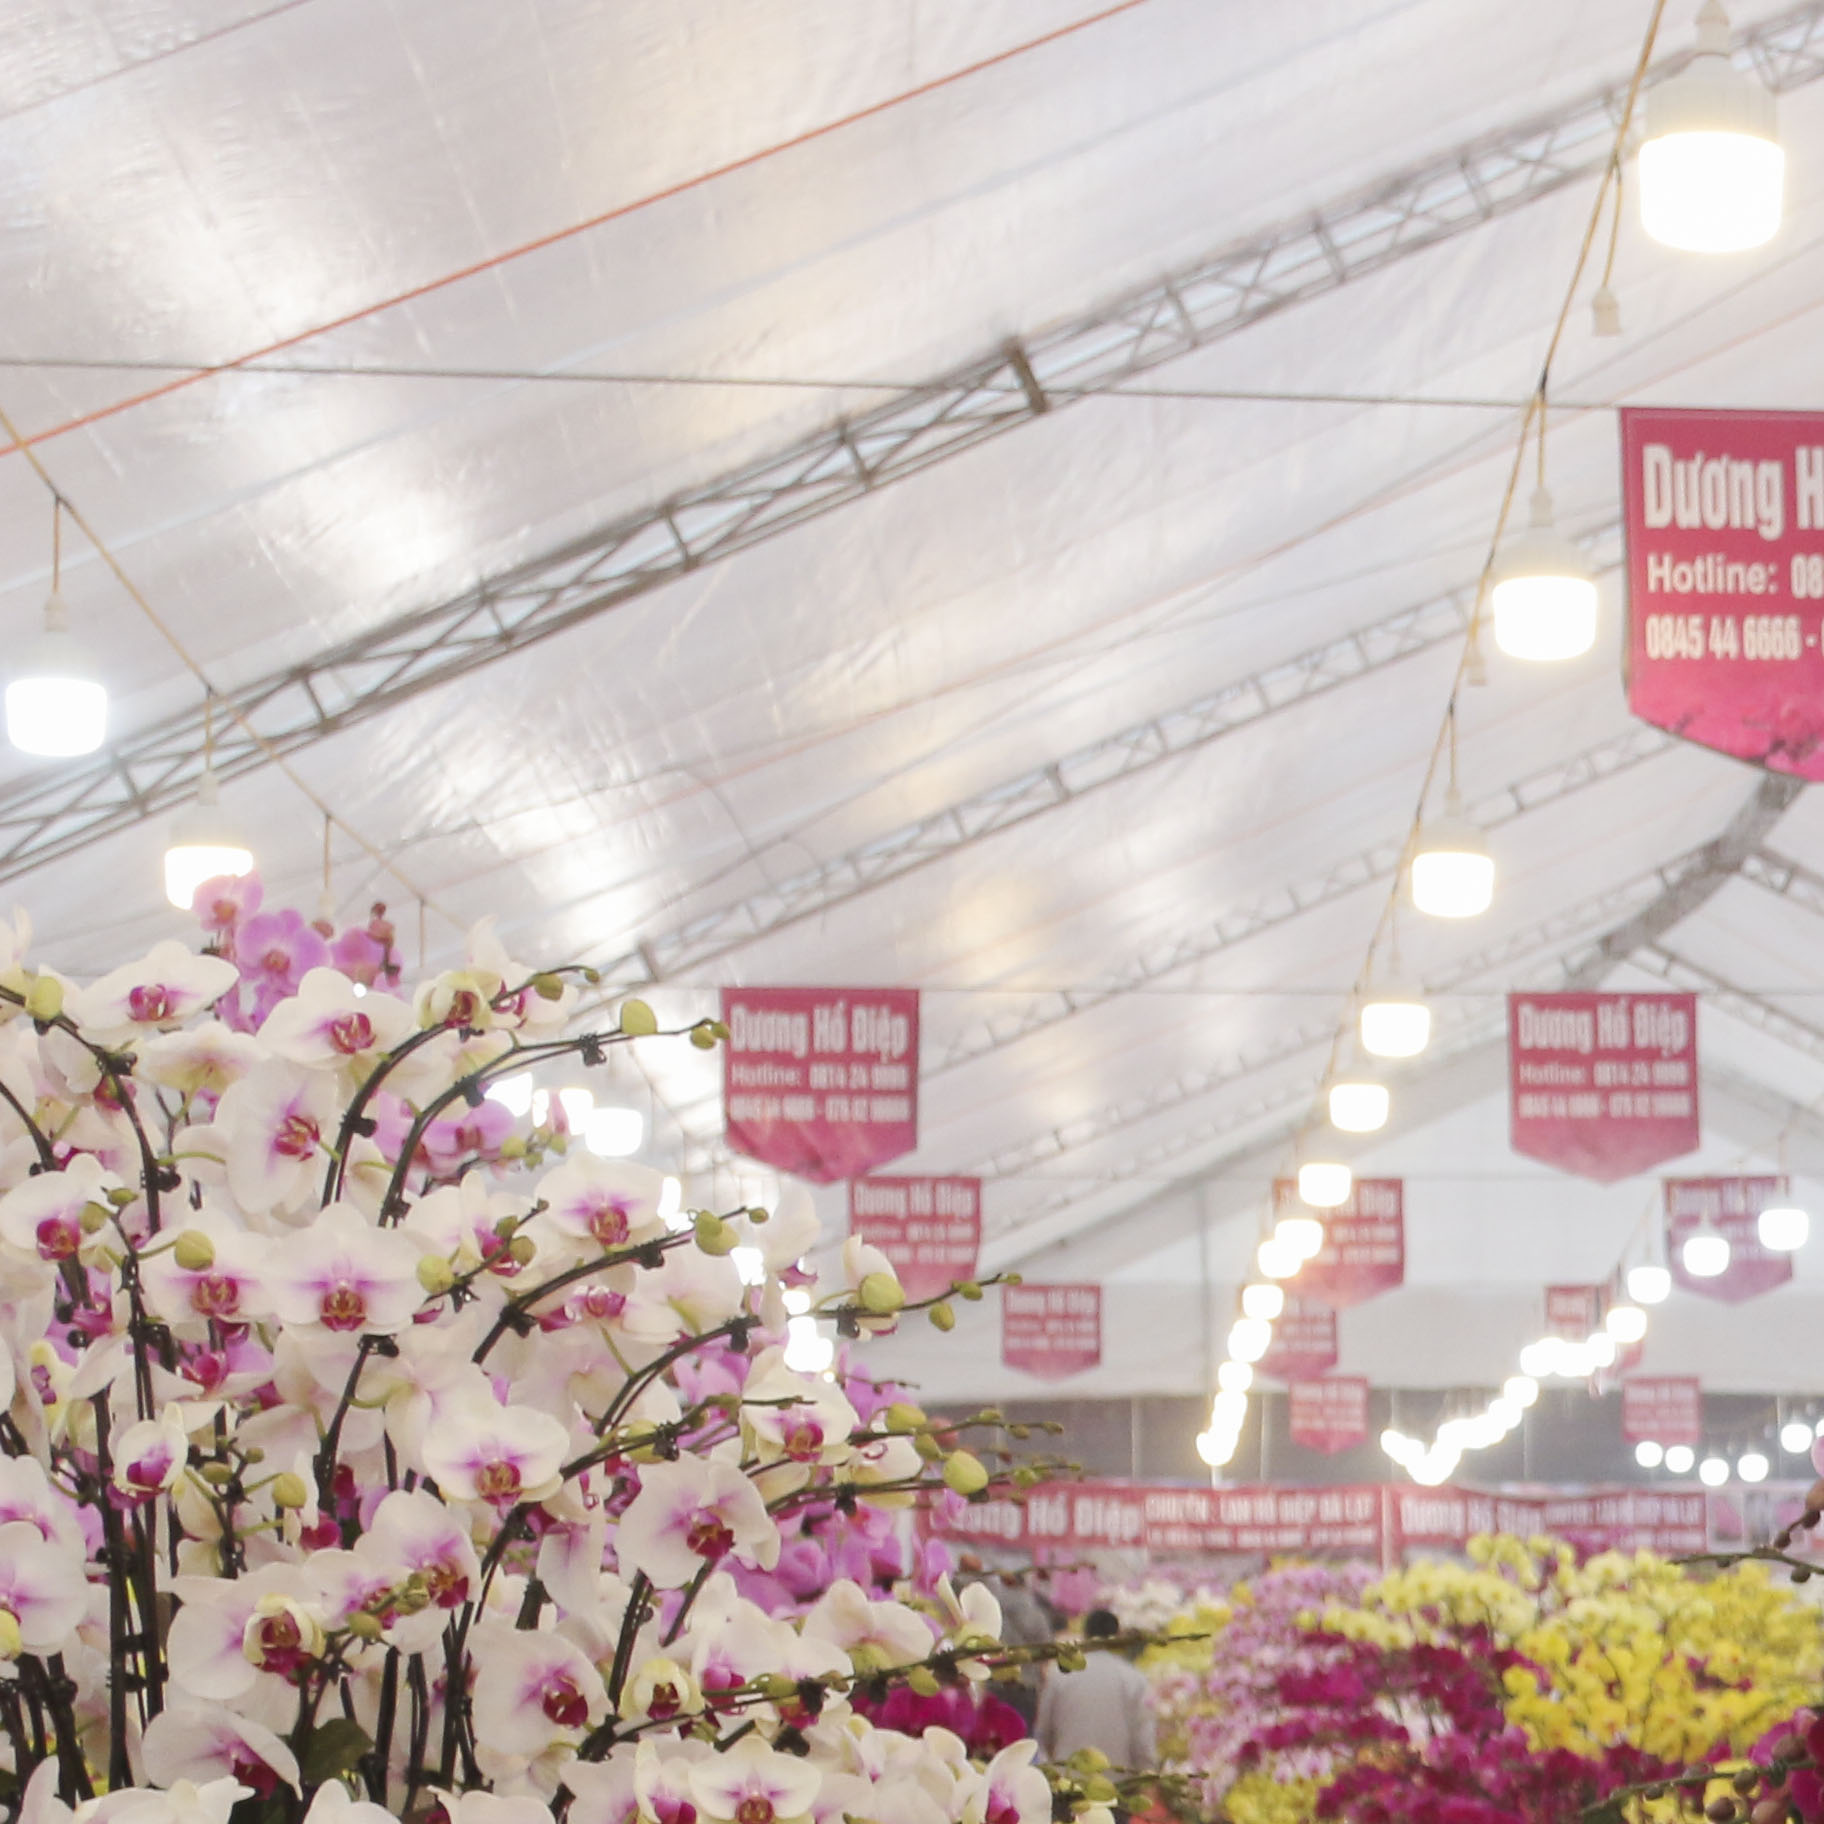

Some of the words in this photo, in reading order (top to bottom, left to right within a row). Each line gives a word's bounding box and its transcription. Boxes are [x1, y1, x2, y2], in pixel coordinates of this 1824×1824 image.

[1643, 442, 1785, 541] Dương
[1647, 552, 1778, 595] Hotline:
[1645, 614, 1702, 660] 0845
[1709, 614, 1738, 660] 44
[1743, 614, 1800, 661] 6666
